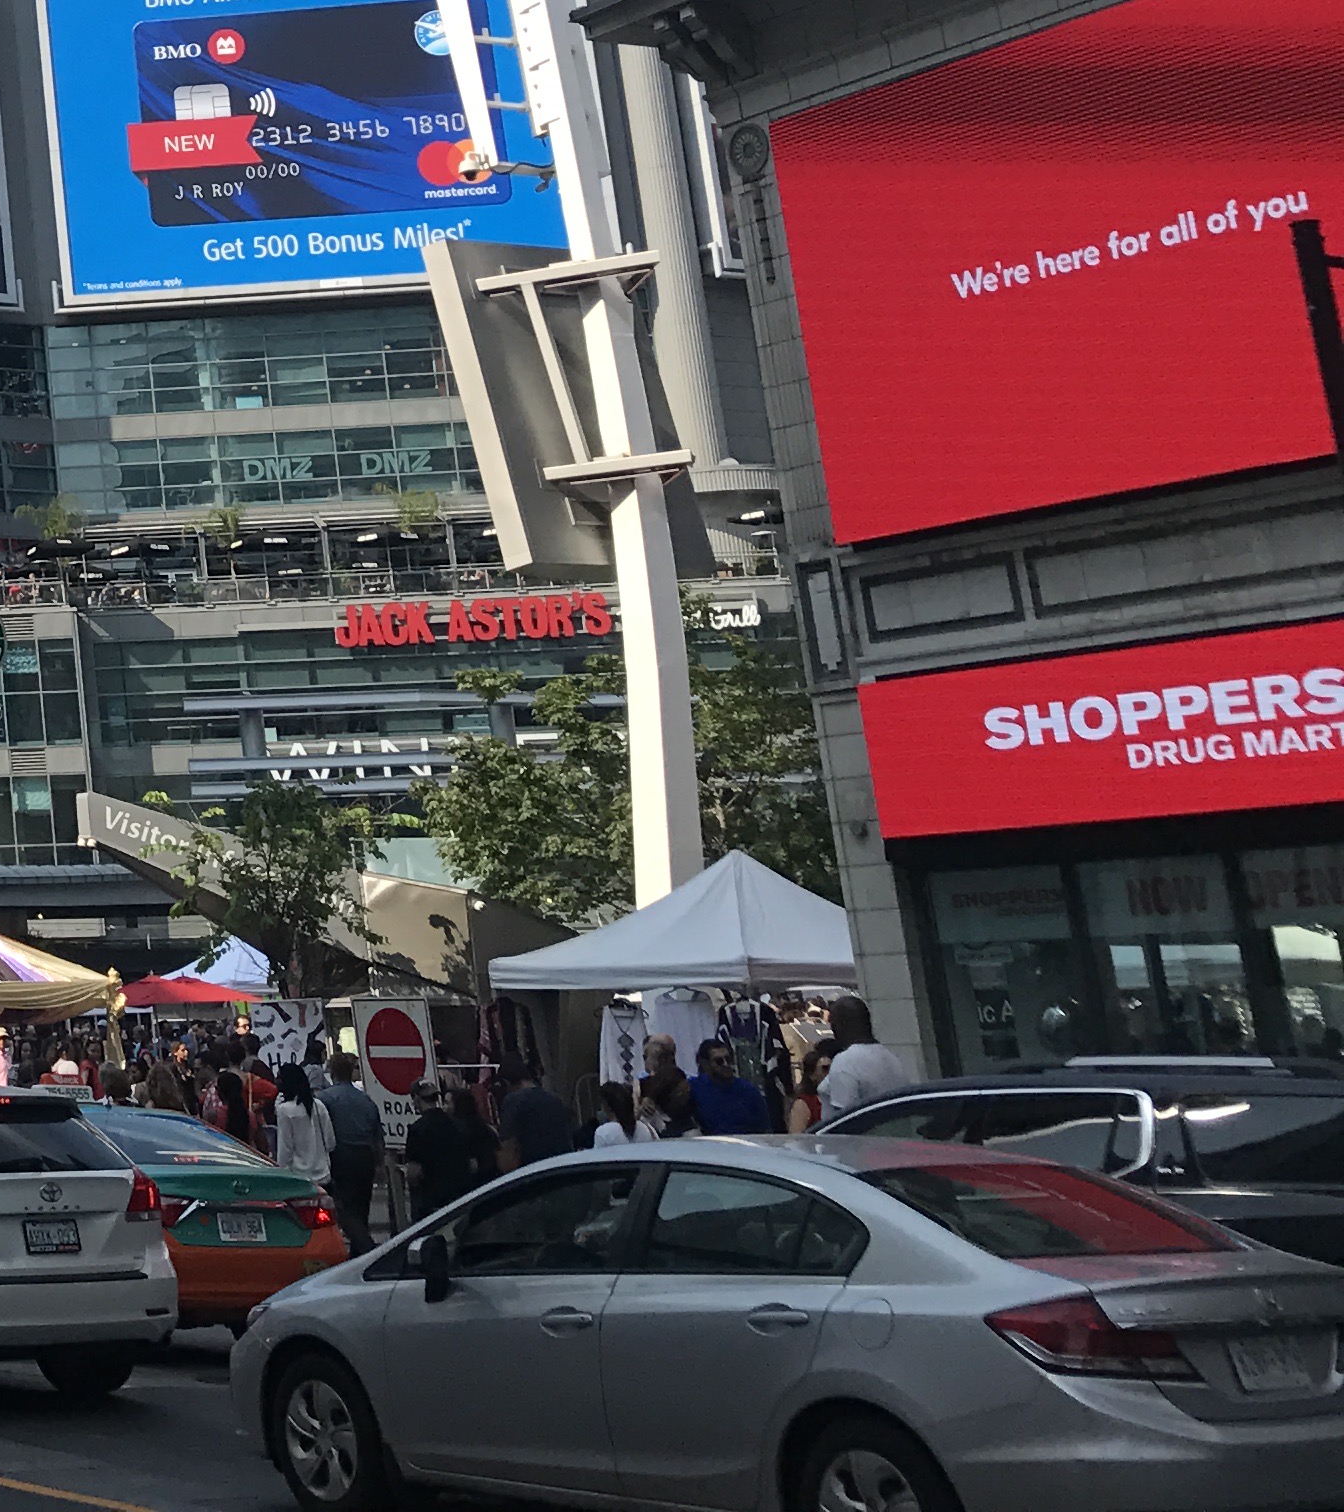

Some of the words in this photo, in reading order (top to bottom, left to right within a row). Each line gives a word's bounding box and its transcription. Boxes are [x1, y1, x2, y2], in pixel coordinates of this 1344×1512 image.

[153, 41, 202, 61] BMO
[163, 133, 216, 153] NEW
[251, 124, 313, 148] 2312
[326, 119, 391, 143] 3456
[403, 113, 467, 136] 7890
[245, 161, 301, 180] 00/00
[174, 183, 186, 201] J
[192, 182, 205, 200] R
[212, 180, 245, 199] ROY
[202, 237, 245, 263] Get
[253, 234, 298, 259] 500
[308, 229, 385, 255] Bonus
[950, 260, 1031, 299] We're
[1035, 244, 1101, 279] here
[1107, 230, 1152, 260] for
[1159, 210, 1199, 248] all
[1206, 199, 1239, 235] of
[1246, 190, 1310, 233] you
[335, 601, 436, 649] JACK
[447, 591, 613, 643] ASTOR'S
[709, 602, 761, 631] Grill
[983, 667, 1344, 751] SHOPPERS
[1125, 733, 1237, 770] DRUG
[1240, 722, 1344, 759] MART
[104, 804, 190, 856] Visitor
[1126, 877, 1209, 916] NOW
